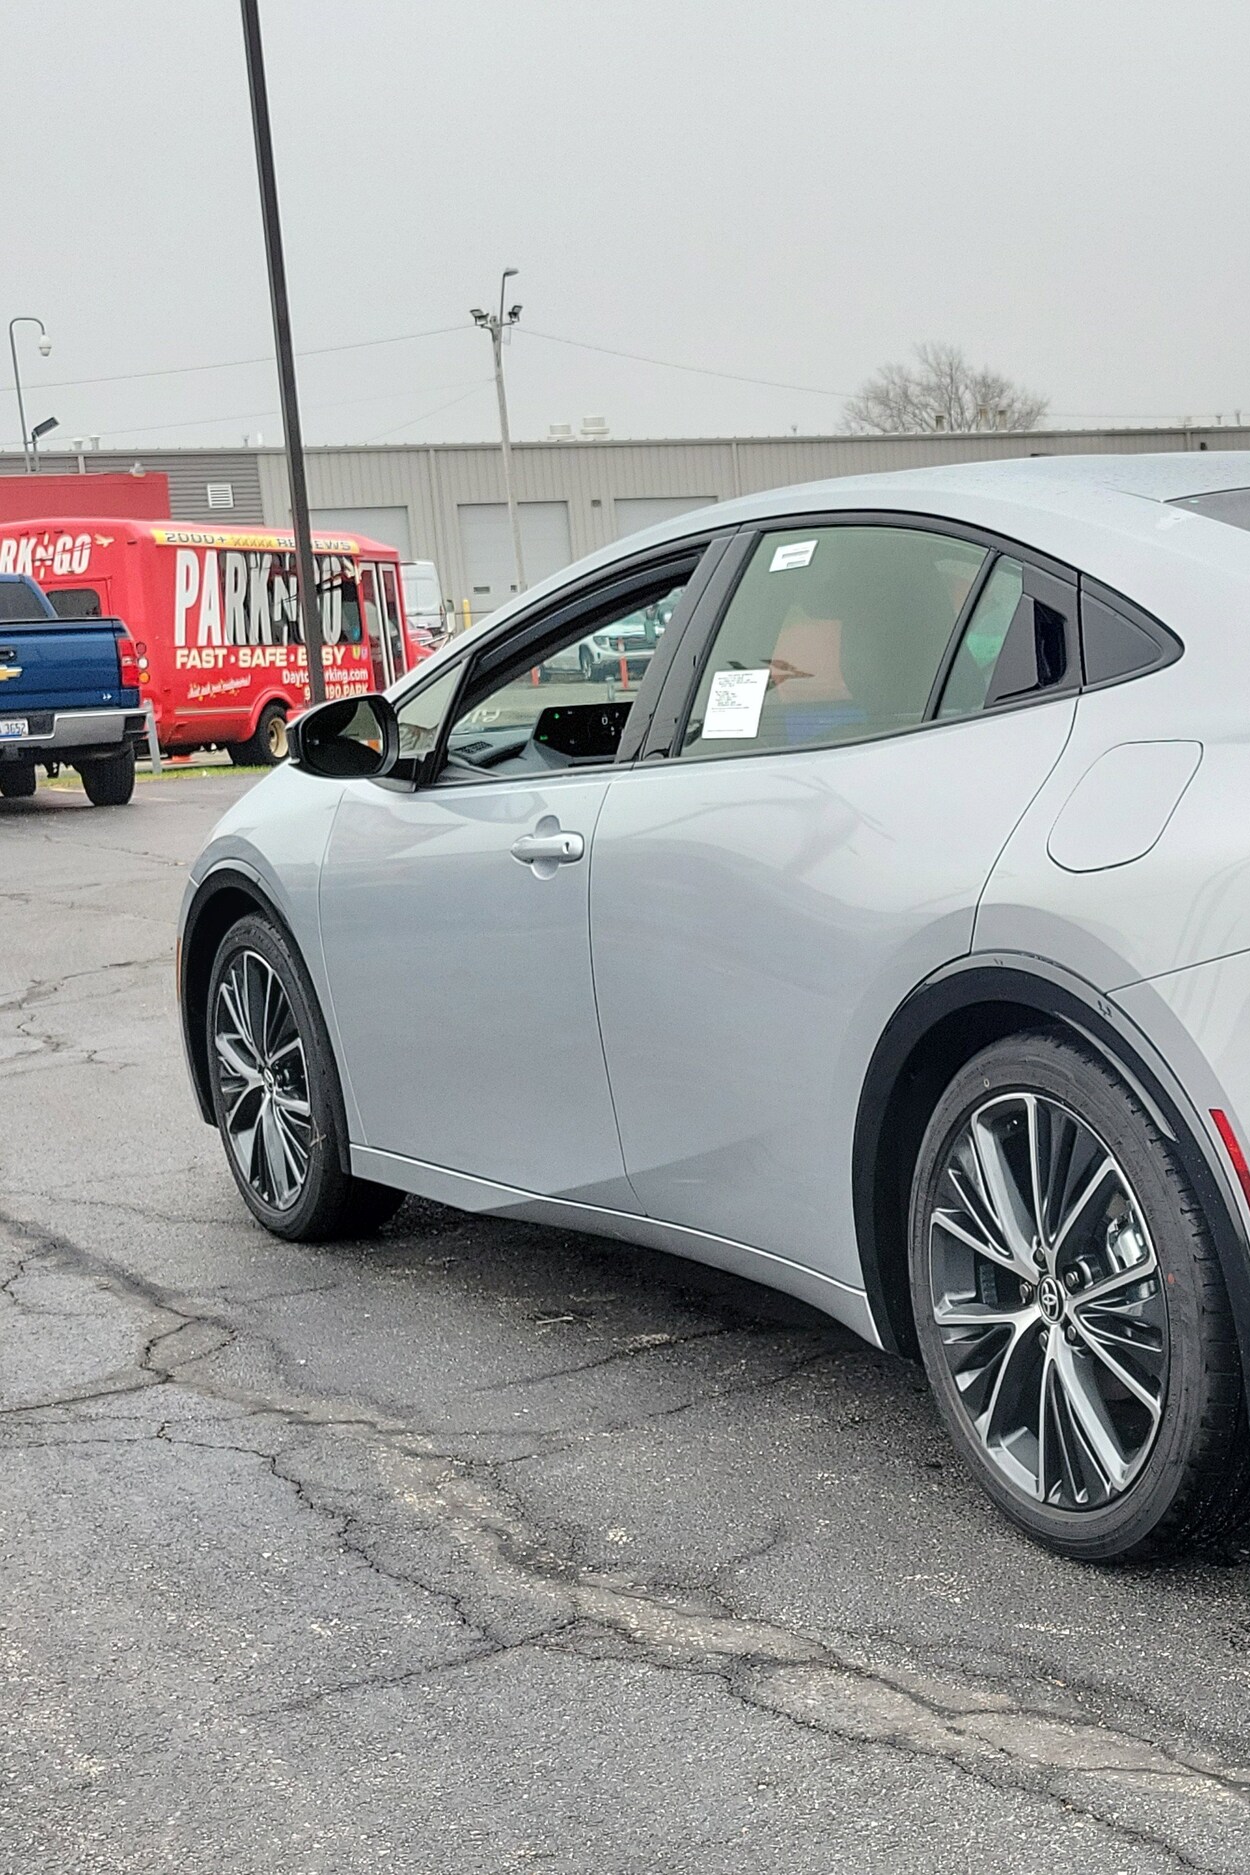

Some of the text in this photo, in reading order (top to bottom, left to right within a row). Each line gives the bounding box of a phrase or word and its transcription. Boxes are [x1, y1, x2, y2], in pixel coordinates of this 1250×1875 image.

[165, 532, 351, 550] 2000+ REEWS
[174, 548, 273, 647] PARK
[176, 646, 346, 669] FAST SAFE ESY
